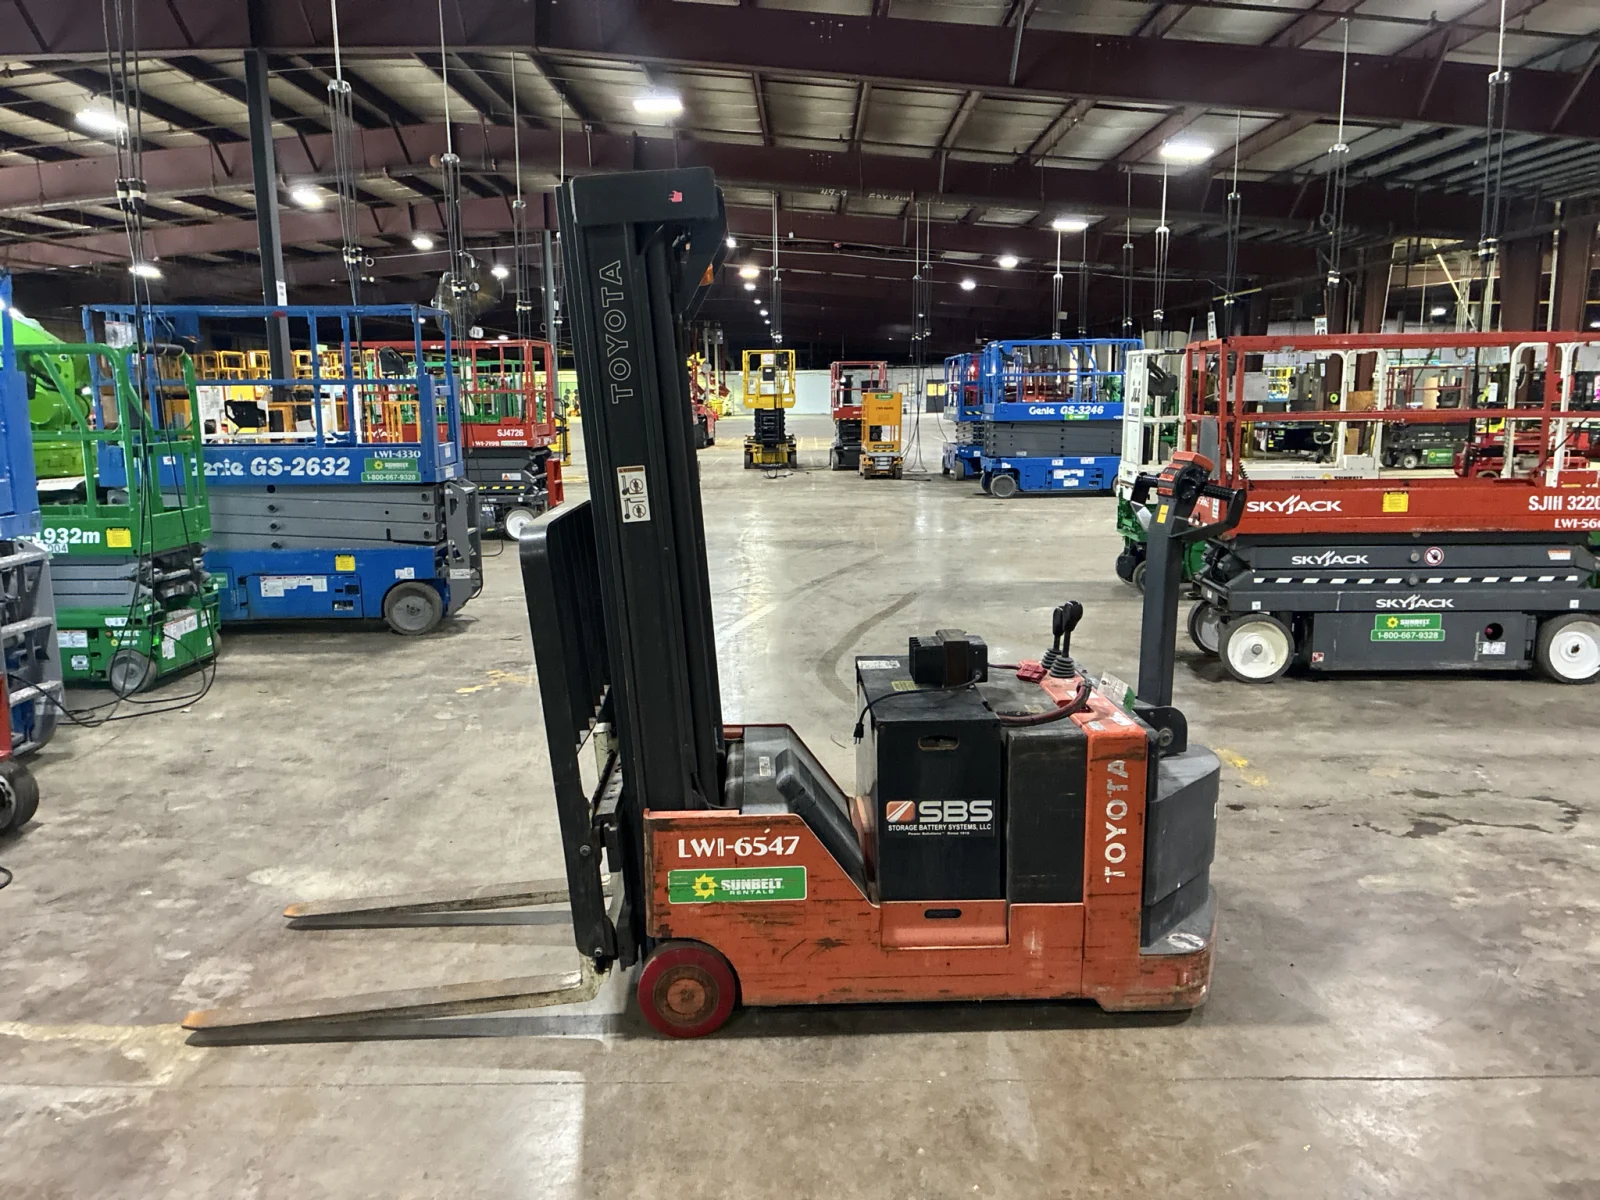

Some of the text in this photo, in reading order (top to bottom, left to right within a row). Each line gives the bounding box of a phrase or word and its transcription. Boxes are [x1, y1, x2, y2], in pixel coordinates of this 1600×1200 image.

[599, 259, 634, 405] TOYOTA
[1028, 406, 1055, 415] Genie
[1060, 405, 1104, 415] GS-3246
[496, 429, 524, 437] SJ4726
[374, 450, 421, 459] LWI-4330
[250, 457, 350, 477] GS-2632
[1246, 494, 1342, 515] SKYJACK
[1291, 550, 1369, 567] SKYJACK
[1376, 594, 1454, 610] SKYJACK
[1377, 631, 1439, 639] 1-800-667-9328
[918, 800, 993, 823] SBS
[888, 824, 918, 832] STORAGE
[948, 823, 978, 831] SYSTEMS,
[1104, 759, 1129, 883] TOYOTA
[678, 836, 800, 858] LWI-6547
[720, 878, 784, 891] SUNBELT
